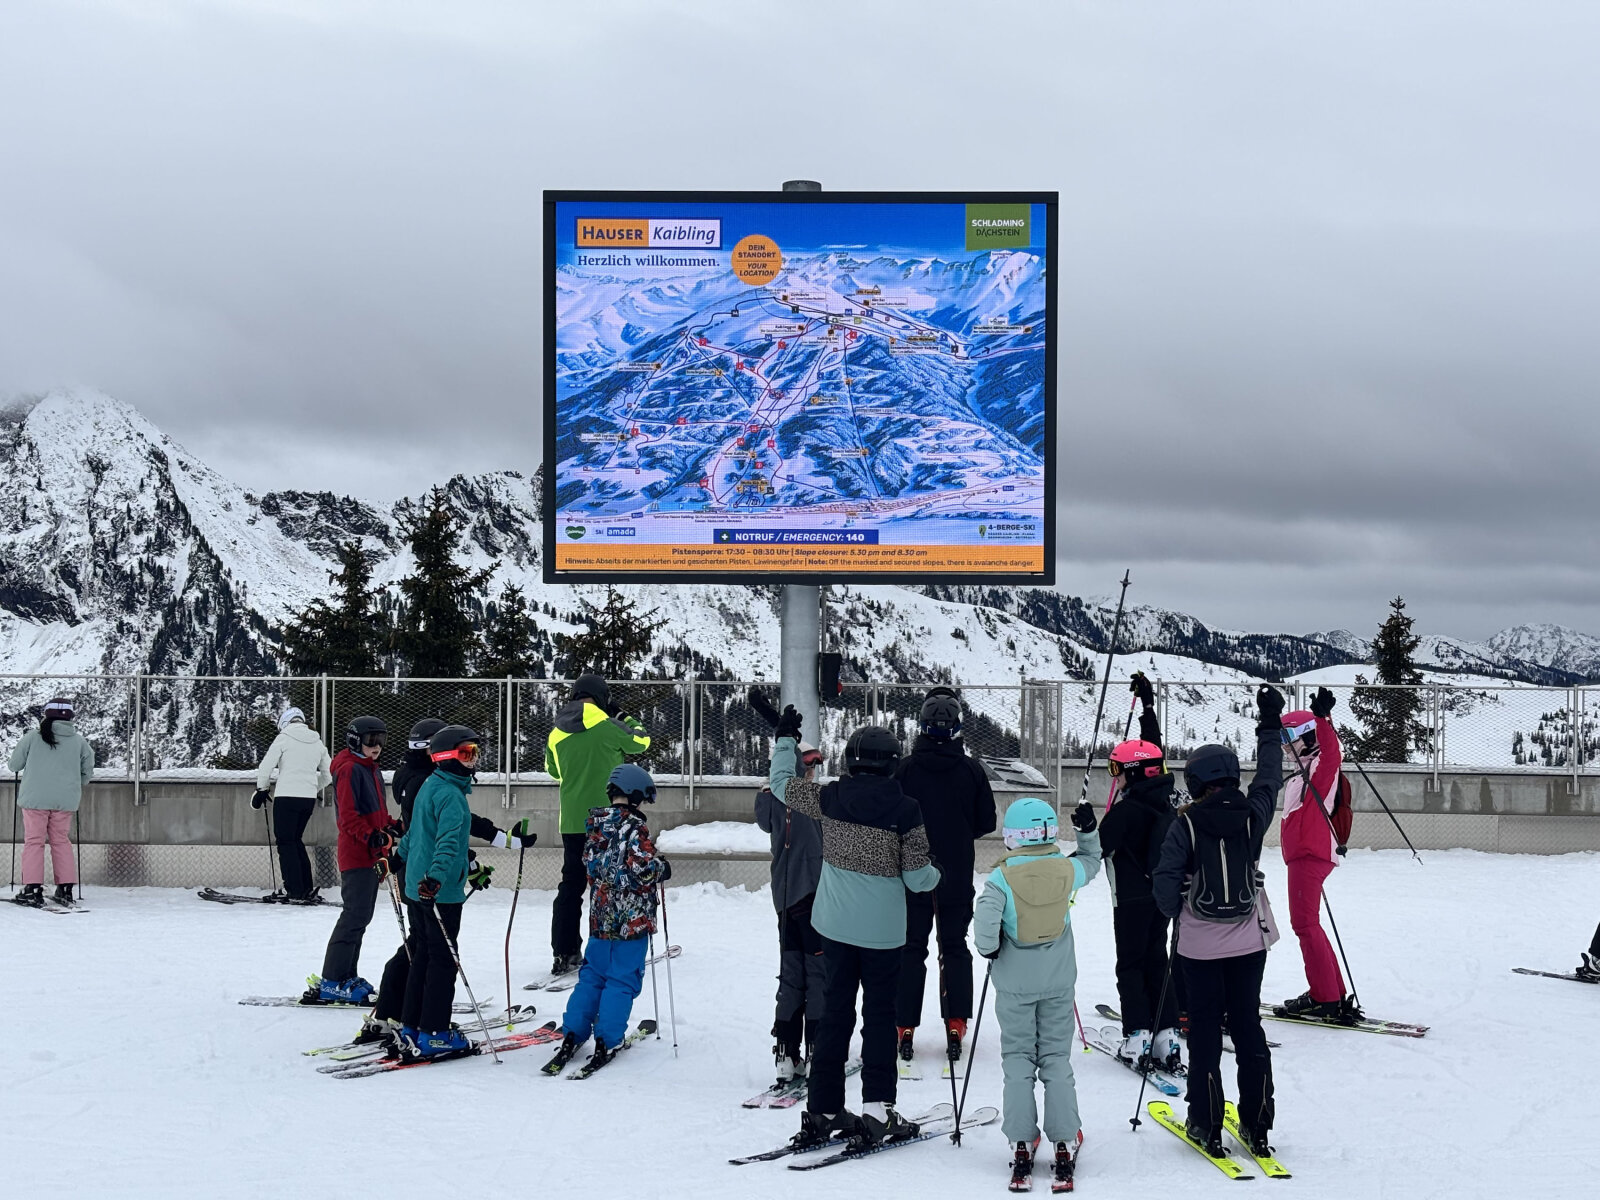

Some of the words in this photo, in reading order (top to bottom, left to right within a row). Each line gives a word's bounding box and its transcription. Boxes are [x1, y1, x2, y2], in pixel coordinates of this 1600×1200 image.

[971, 219, 1025, 227] SCHLADMING
[582, 226, 643, 240] HAUSER
[653, 226, 716, 245] Kaibling
[577, 255, 632, 266] Herzlich
[635, 255, 720, 267] willkommen.
[735, 533, 774, 541] NOTRUF
[783, 533, 845, 542] EMERGENCY:
[846, 533, 865, 542] 140
[672, 548, 724, 557] Pistensperre:
[726, 548, 746, 556] 17:30
[753, 548, 775, 556] 08:30
[776, 548, 790, 556] Uhr
[795, 548, 817, 557] Slope
[818, 548, 848, 556] closure:
[565, 557, 594, 565] Hinweis:
[595, 557, 621, 565] Abseits
[622, 557, 633, 565] der
[634, 557, 671, 565] markierten
[687, 558, 727, 567] gesicherten
[753, 558, 803, 567] Lawinengefahr
[852, 558, 878, 566] marked
[879, 558, 893, 566] and
[1009, 559, 1035, 567] danger.
